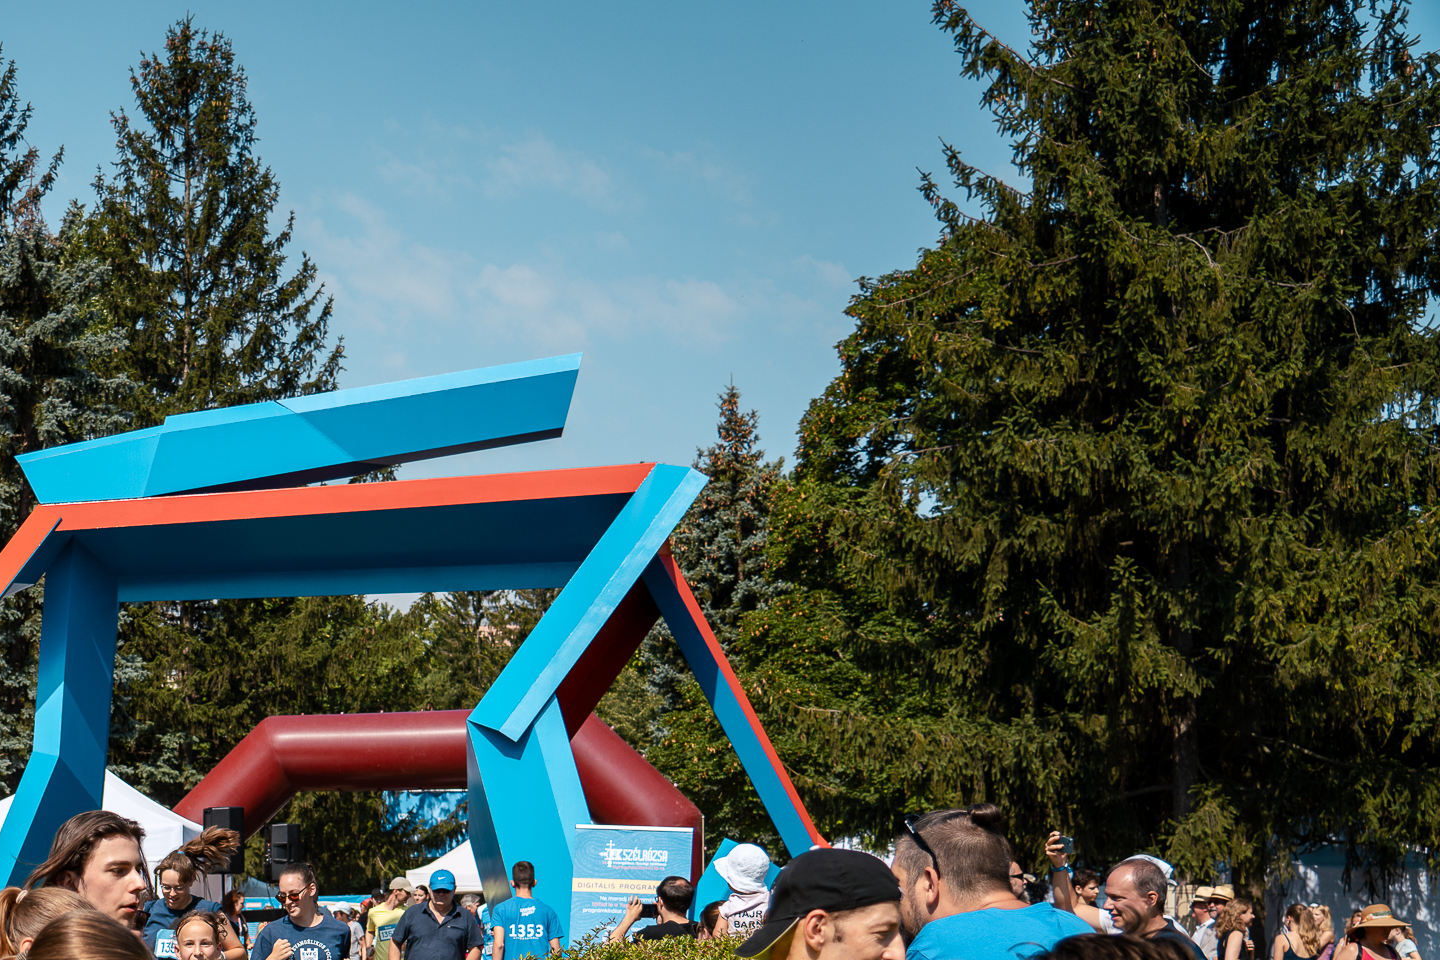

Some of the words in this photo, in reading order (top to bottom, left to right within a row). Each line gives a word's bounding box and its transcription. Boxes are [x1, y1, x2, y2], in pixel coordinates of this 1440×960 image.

[622, 846, 668, 863] SZÉLRÓZSA
[577, 881, 616, 889] DIGITÁLIS
[619, 883, 658, 891] PROGRAM
[733, 910, 763, 918] HAJR
[509, 923, 544, 938] 1353
